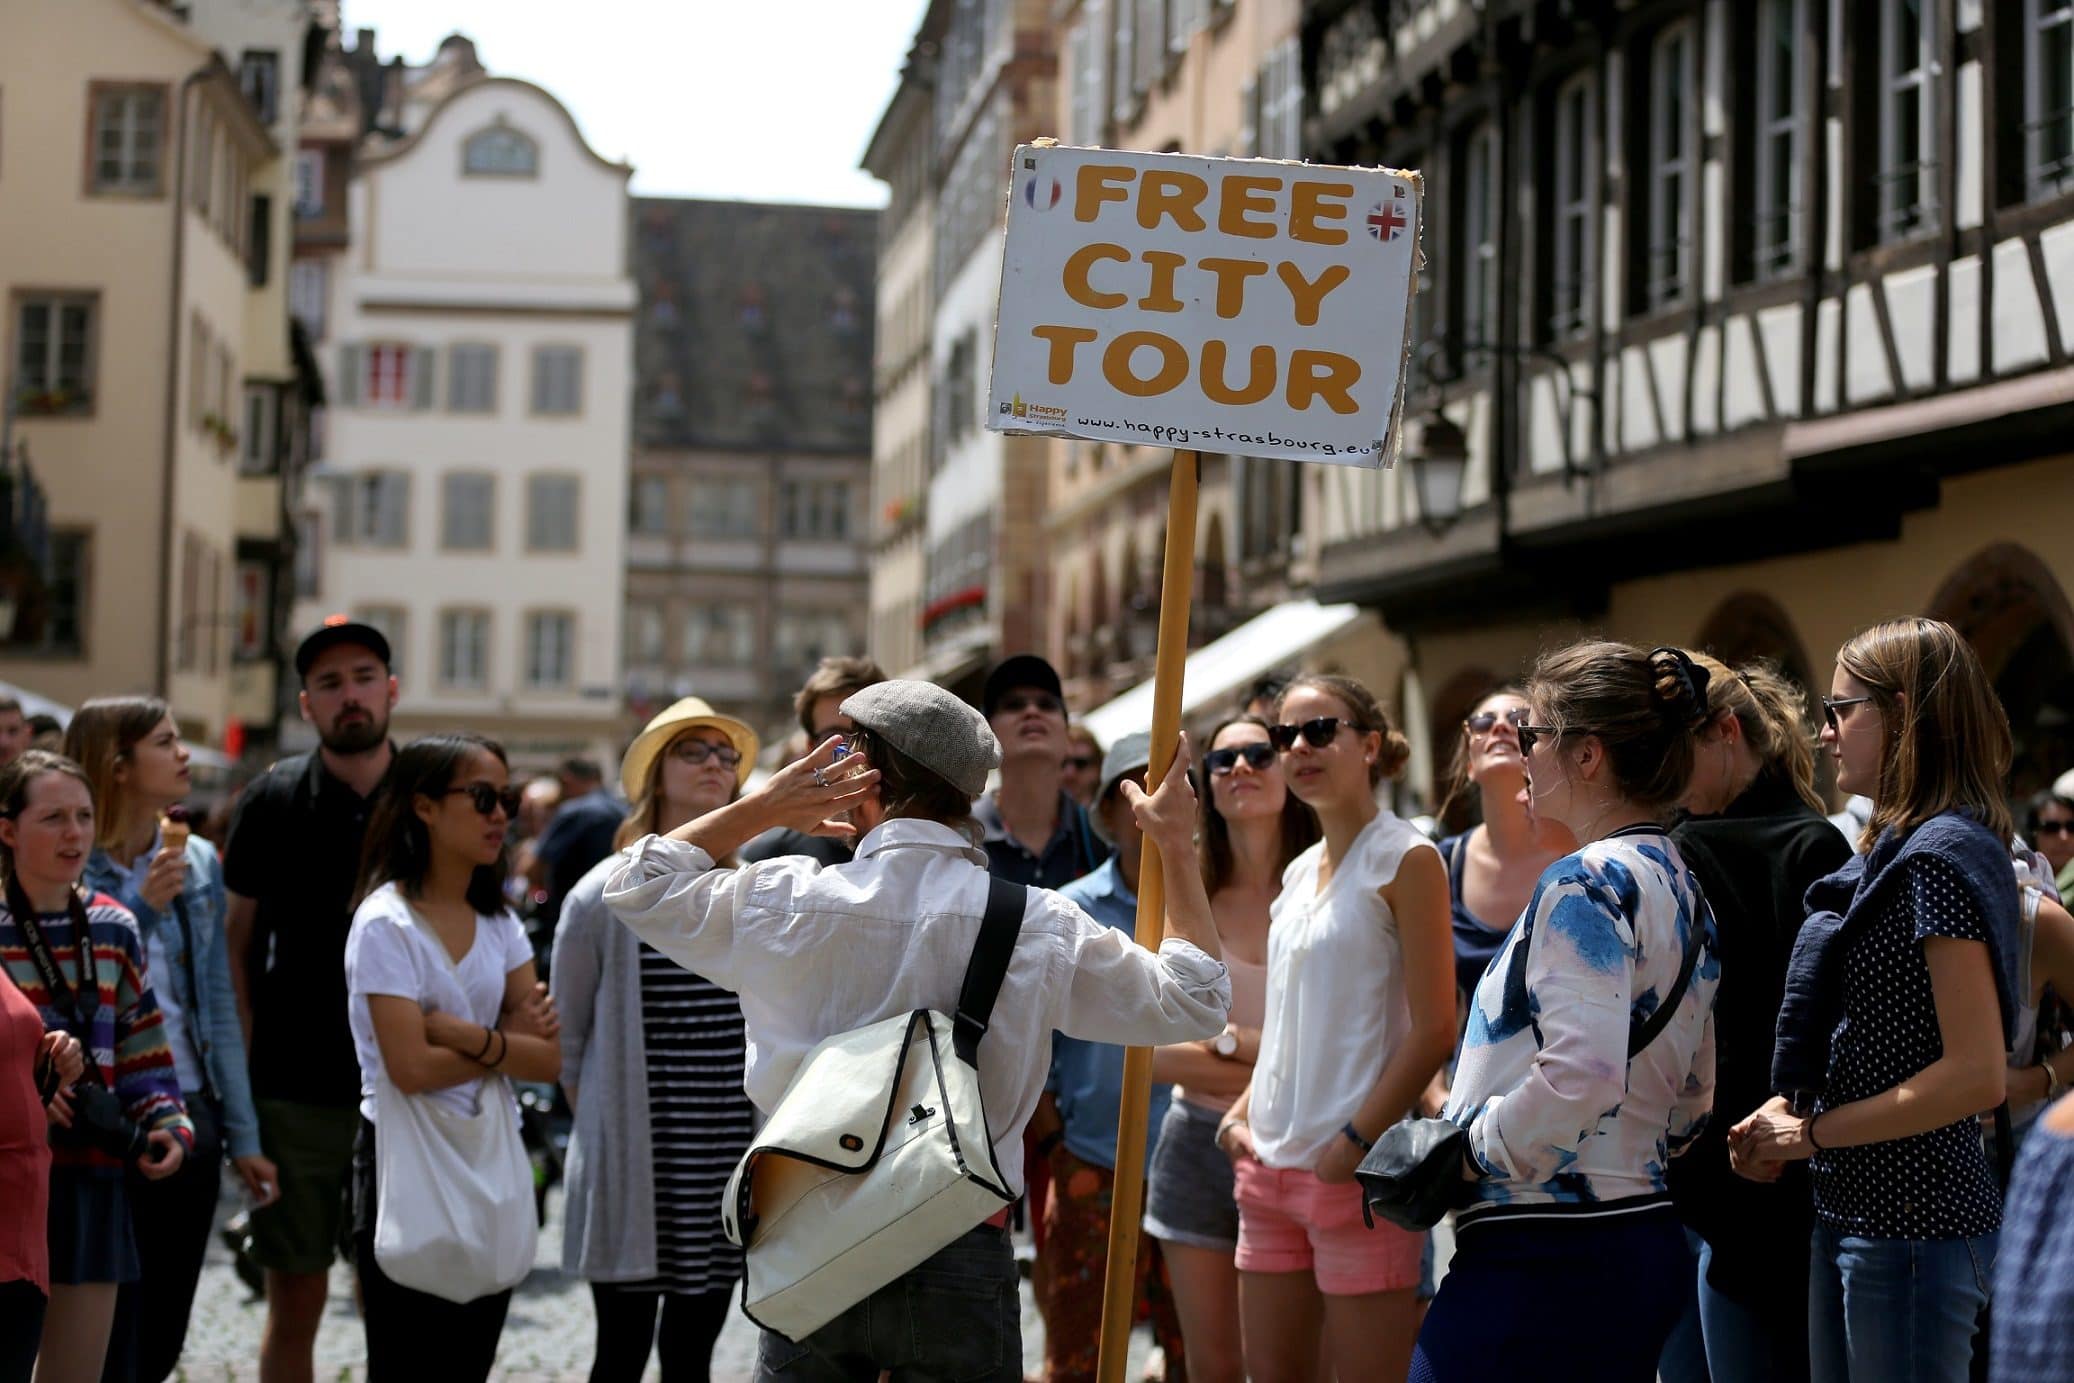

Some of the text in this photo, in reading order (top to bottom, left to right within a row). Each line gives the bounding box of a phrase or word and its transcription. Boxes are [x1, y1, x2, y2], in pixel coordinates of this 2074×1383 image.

[1074, 164, 1354, 245] FREE
[1062, 243, 1350, 326] CITY
[1029, 403, 1068, 416] Happy
[1031, 325, 1362, 415] TOUR
[1078, 416, 1370, 456] www.happy-strasbourg.eu
